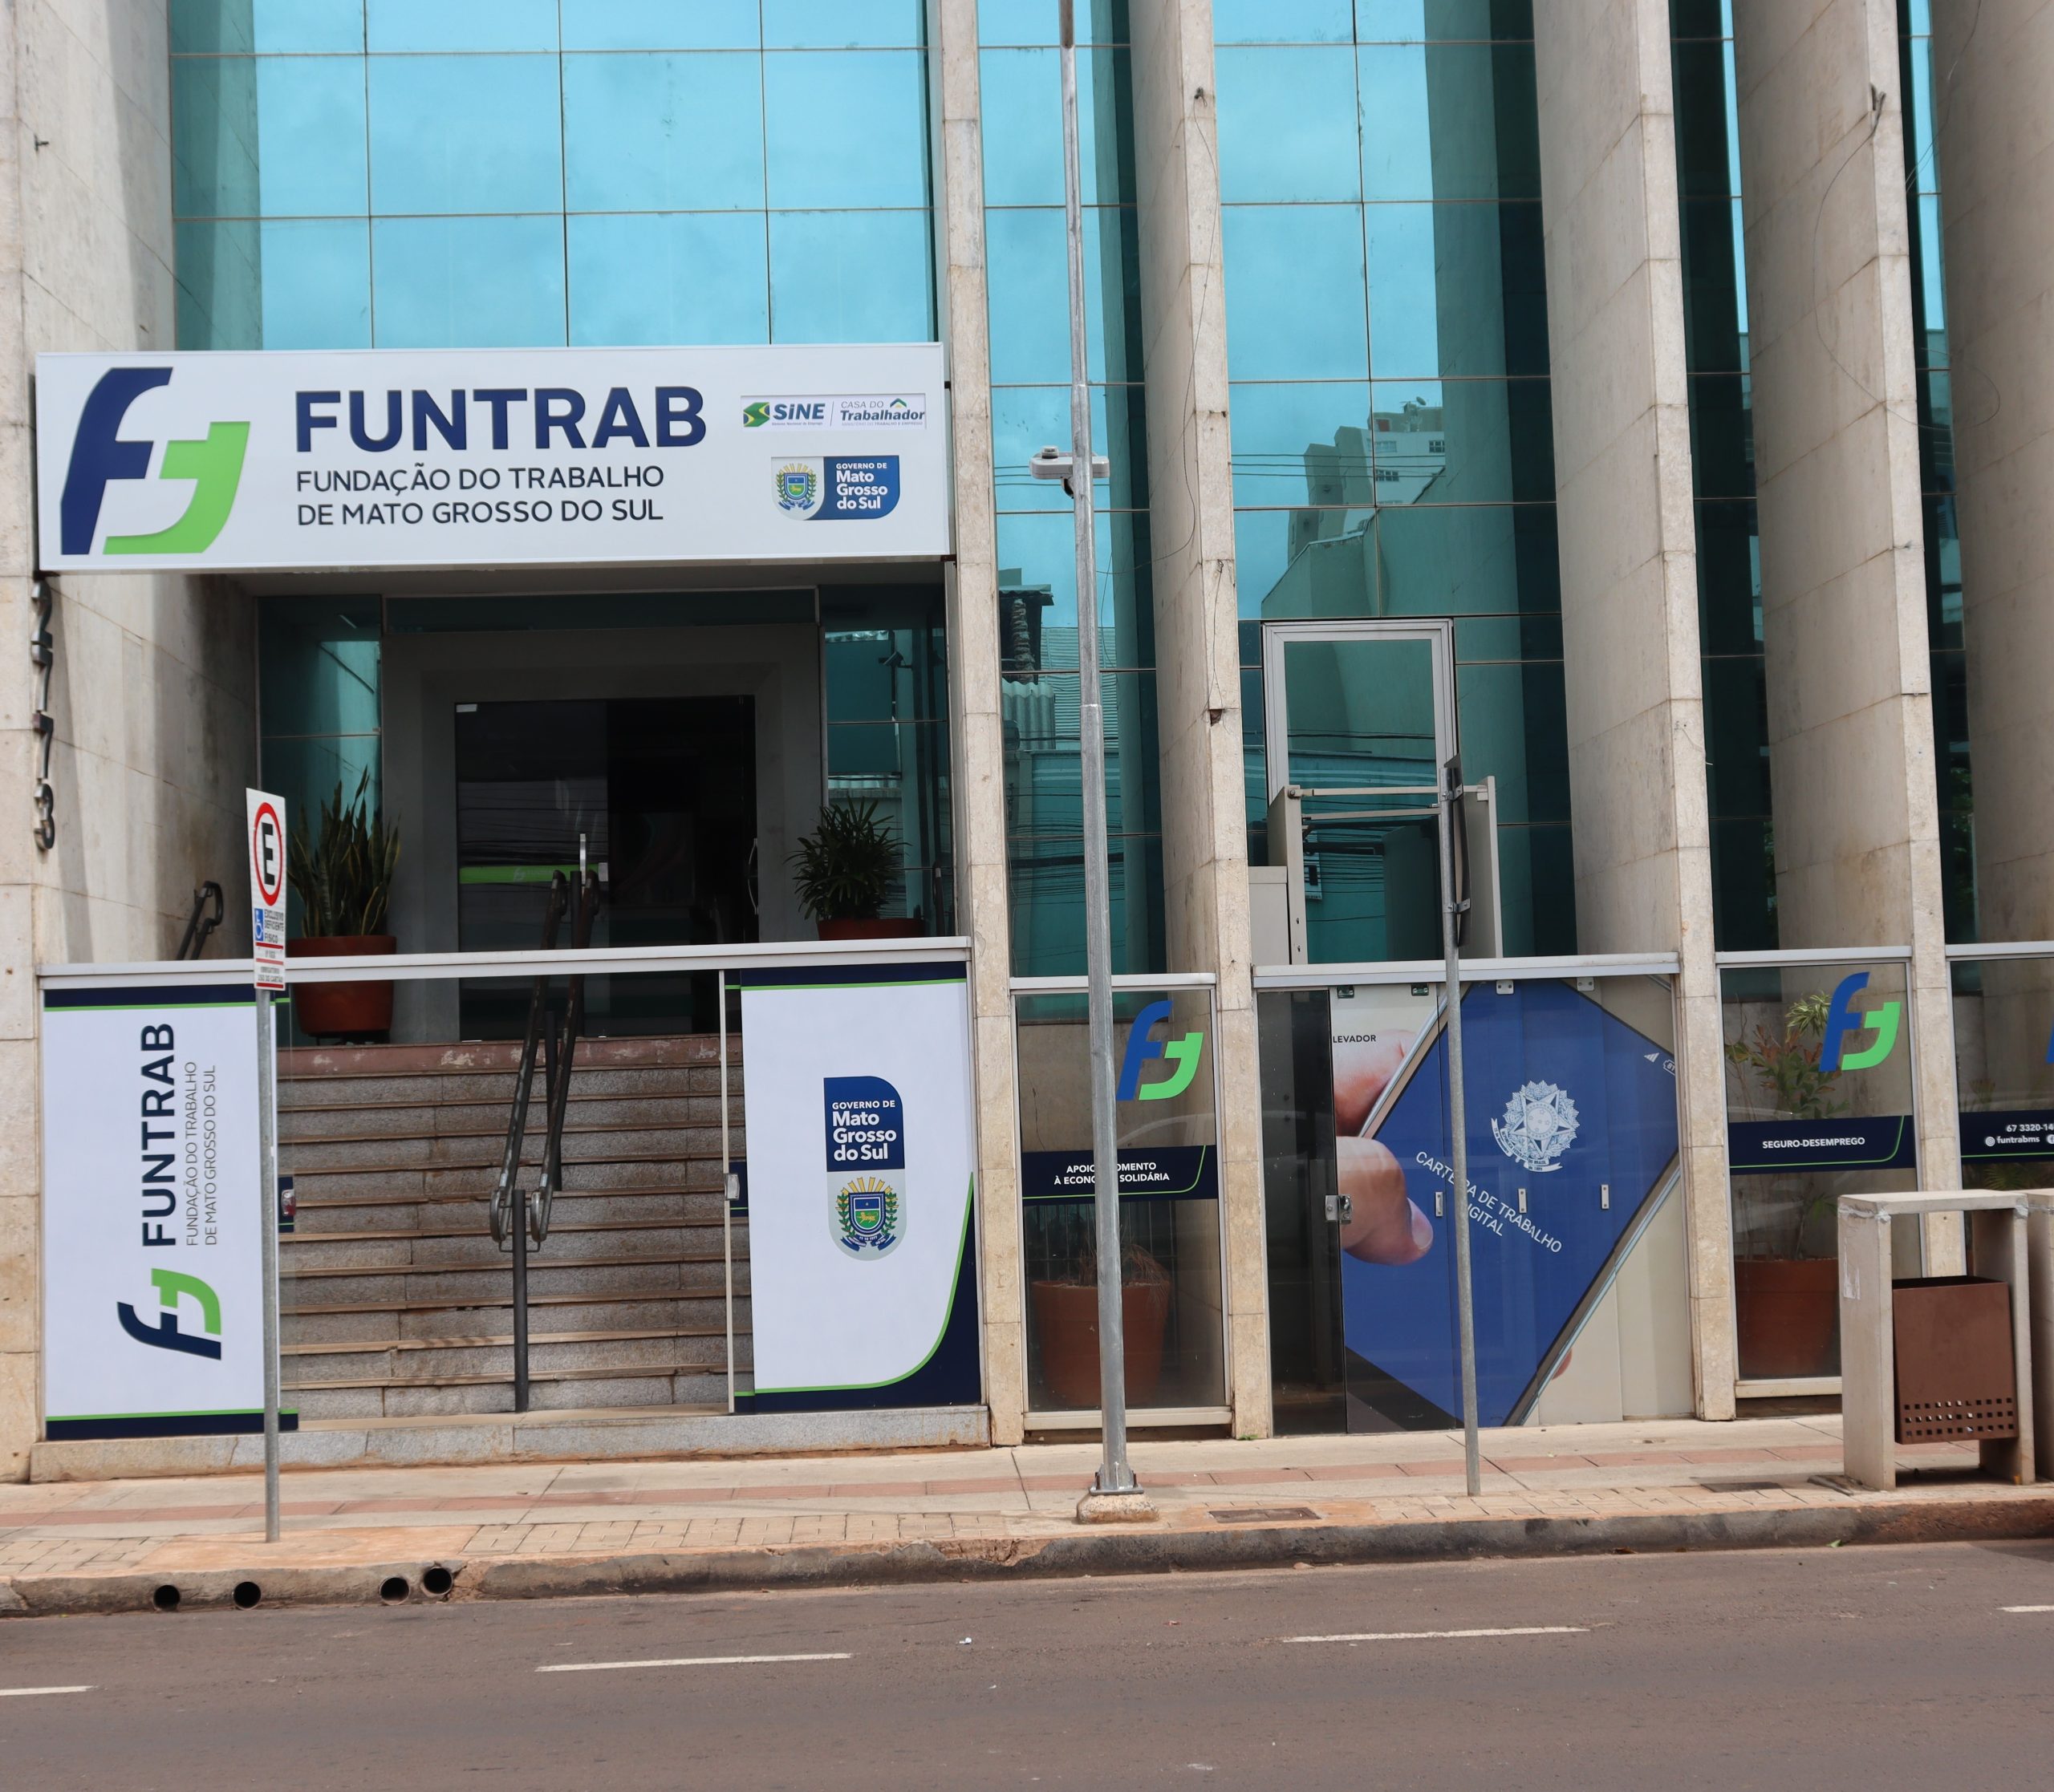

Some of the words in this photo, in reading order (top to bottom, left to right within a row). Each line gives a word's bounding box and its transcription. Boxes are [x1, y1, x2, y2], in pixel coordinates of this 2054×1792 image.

[841, 400, 867, 409] CASA
[869, 400, 884, 408] DO
[295, 386, 706, 452] FUNTRAB
[840, 409, 925, 421] Trabalhador
[297, 462, 451, 497] FUNDAÇÃO
[458, 468, 501, 490] DO
[508, 465, 664, 489] TRABALHO
[836, 470, 875, 483] Mato
[836, 483, 888, 496] Grosso
[836, 496, 857, 509] do
[859, 496, 881, 509] Sul
[298, 503, 334, 526] DE
[342, 502, 424, 525] MATO
[432, 500, 553, 525] GROSSO
[561, 499, 603, 521] DO
[611, 499, 664, 521] SUL
[262, 821, 275, 886] E
[1333, 1034, 1377, 1044] LEVADOR
[203, 1065, 215, 1092] SUL
[185, 1061, 197, 1139] TRABALHO
[203, 1095, 216, 1117] DO
[832, 1101, 880, 1110] GOVERNO
[882, 1100, 895, 1108] DE
[832, 1110, 879, 1127] Mato
[2006, 1124, 2018, 1133] 67
[2019, 1123, 2054, 1132] 3320-14
[140, 1024, 176, 1247] FUNTRAB
[833, 1127, 897, 1144] Grosso
[1762, 1137, 1865, 1149] SEGURO-DESEMPREGO
[1996, 1135, 2040, 1144] funtrabms
[185, 1142, 198, 1164] DO
[204, 1120, 217, 1180] GROSSO
[834, 1144, 859, 1161] do
[860, 1142, 888, 1161] Sul
[1117, 1162, 1156, 1171] OMENTO
[1053, 1175, 1062, 1185] À
[1119, 1172, 1170, 1182] SOLIDÁRIA
[183, 1166, 201, 1246] FUNDAÇÃO
[205, 1182, 217, 1223] MATO
[1467, 1203, 1503, 1237] IGITAL
[1478, 1190, 1498, 1210] DE
[1496, 1202, 1562, 1253] TRABALHO
[205, 1226, 217, 1245] DE
